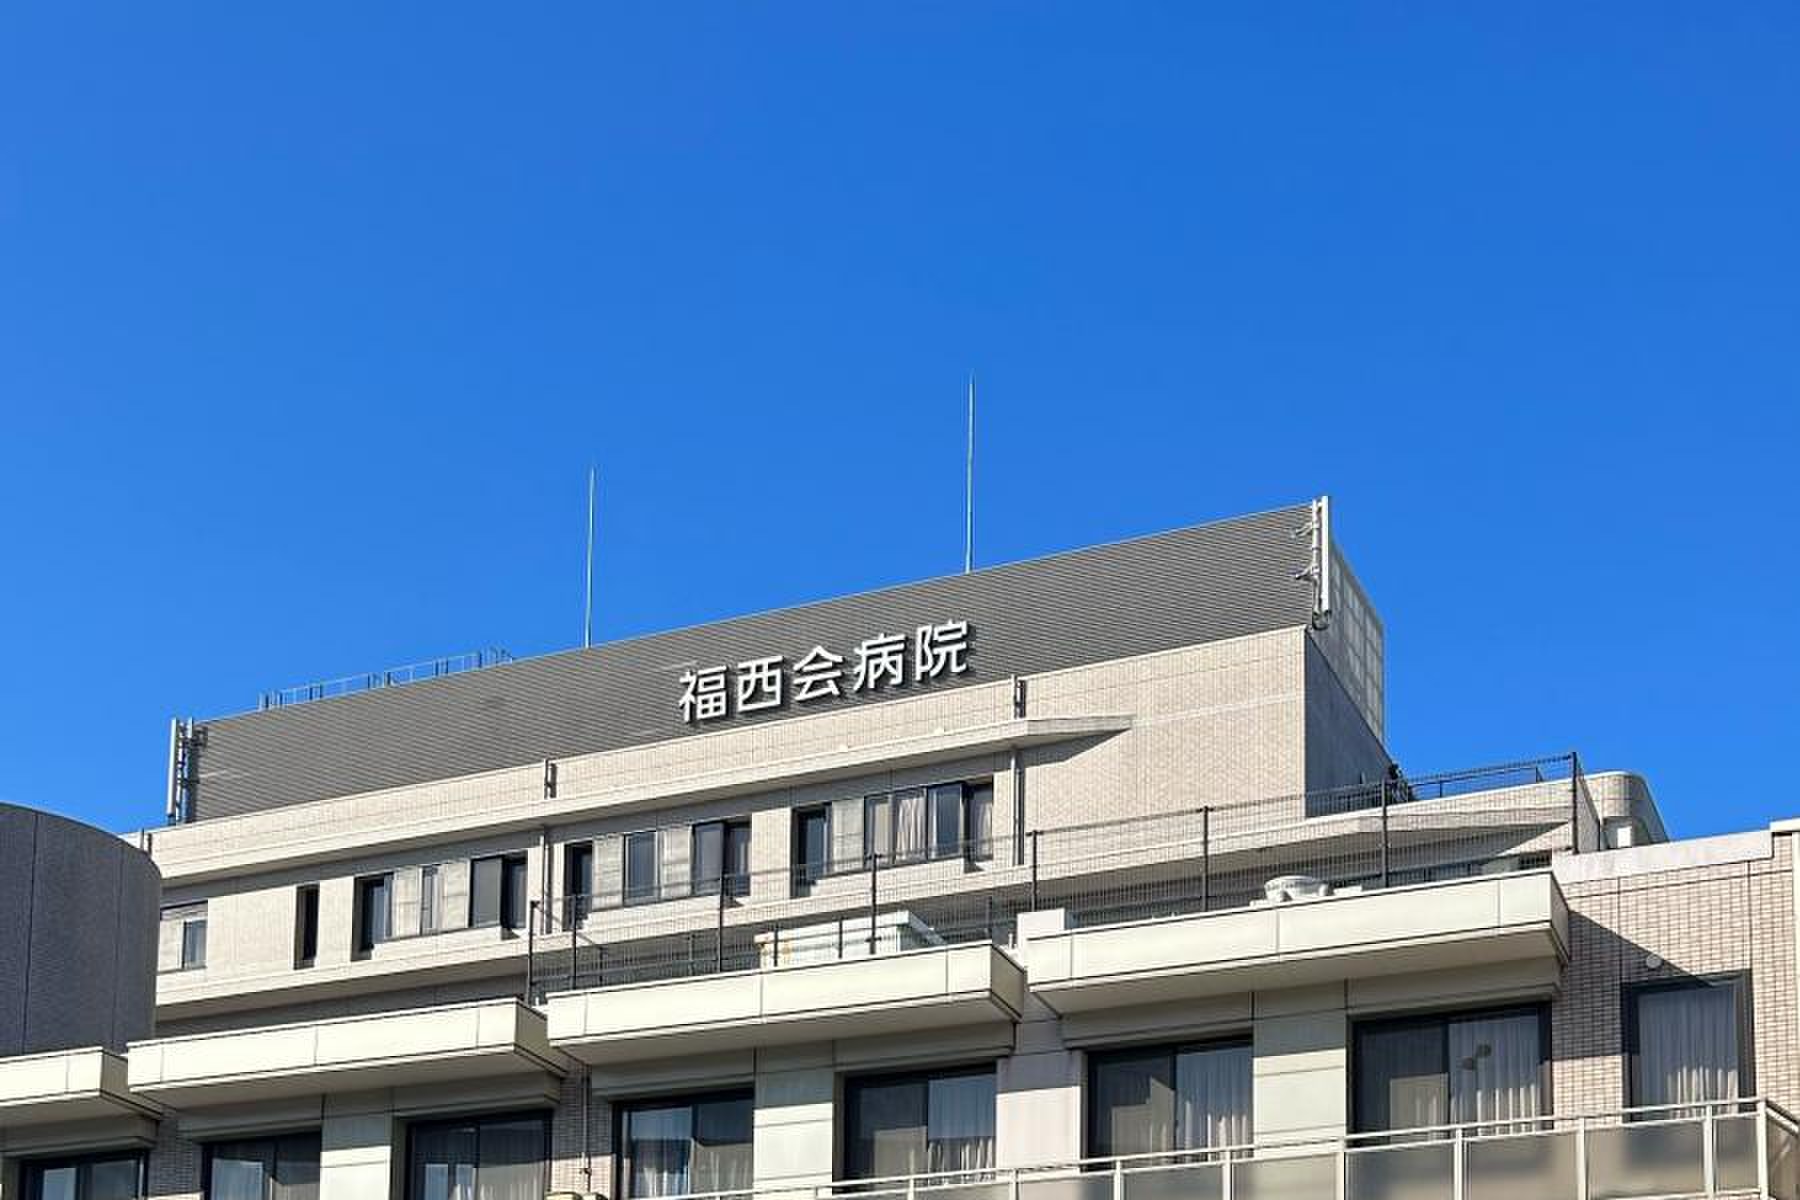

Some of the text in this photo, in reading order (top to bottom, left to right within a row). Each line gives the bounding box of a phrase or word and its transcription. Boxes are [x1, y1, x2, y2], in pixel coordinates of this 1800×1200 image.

[678, 619, 968, 723] 福西会病院
